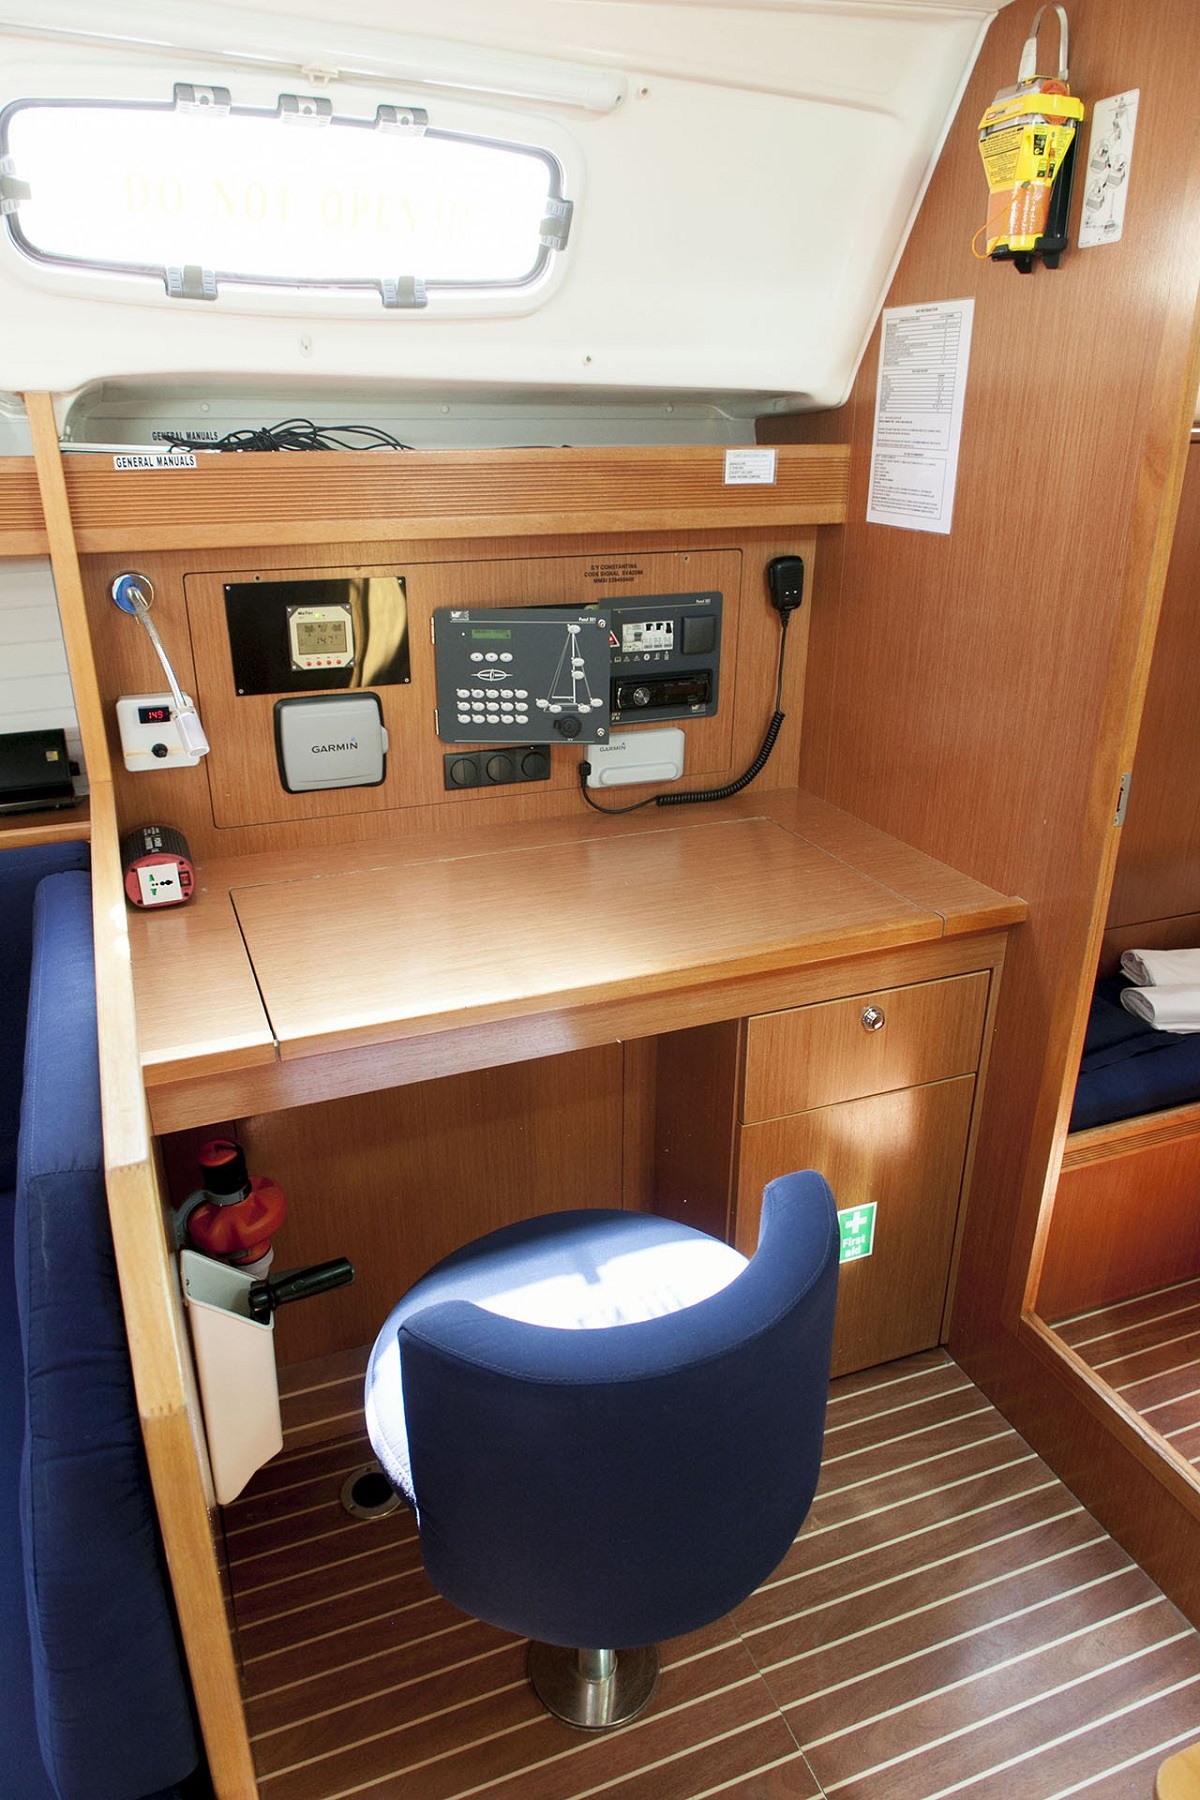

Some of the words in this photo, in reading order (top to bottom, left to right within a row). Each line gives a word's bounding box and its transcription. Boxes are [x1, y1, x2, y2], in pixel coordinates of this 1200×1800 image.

[122, 170, 184, 216] DO
[213, 177, 292, 225] NOT
[186, 432, 218, 441] MANUALS
[115, 456, 154, 468] GENERAL
[156, 455, 195, 467] MANUALS
[311, 741, 359, 755] GARMIN
[599, 744, 627, 753] GARMIN
[842, 1235, 866, 1248] First
[845, 1245, 861, 1257] aid
